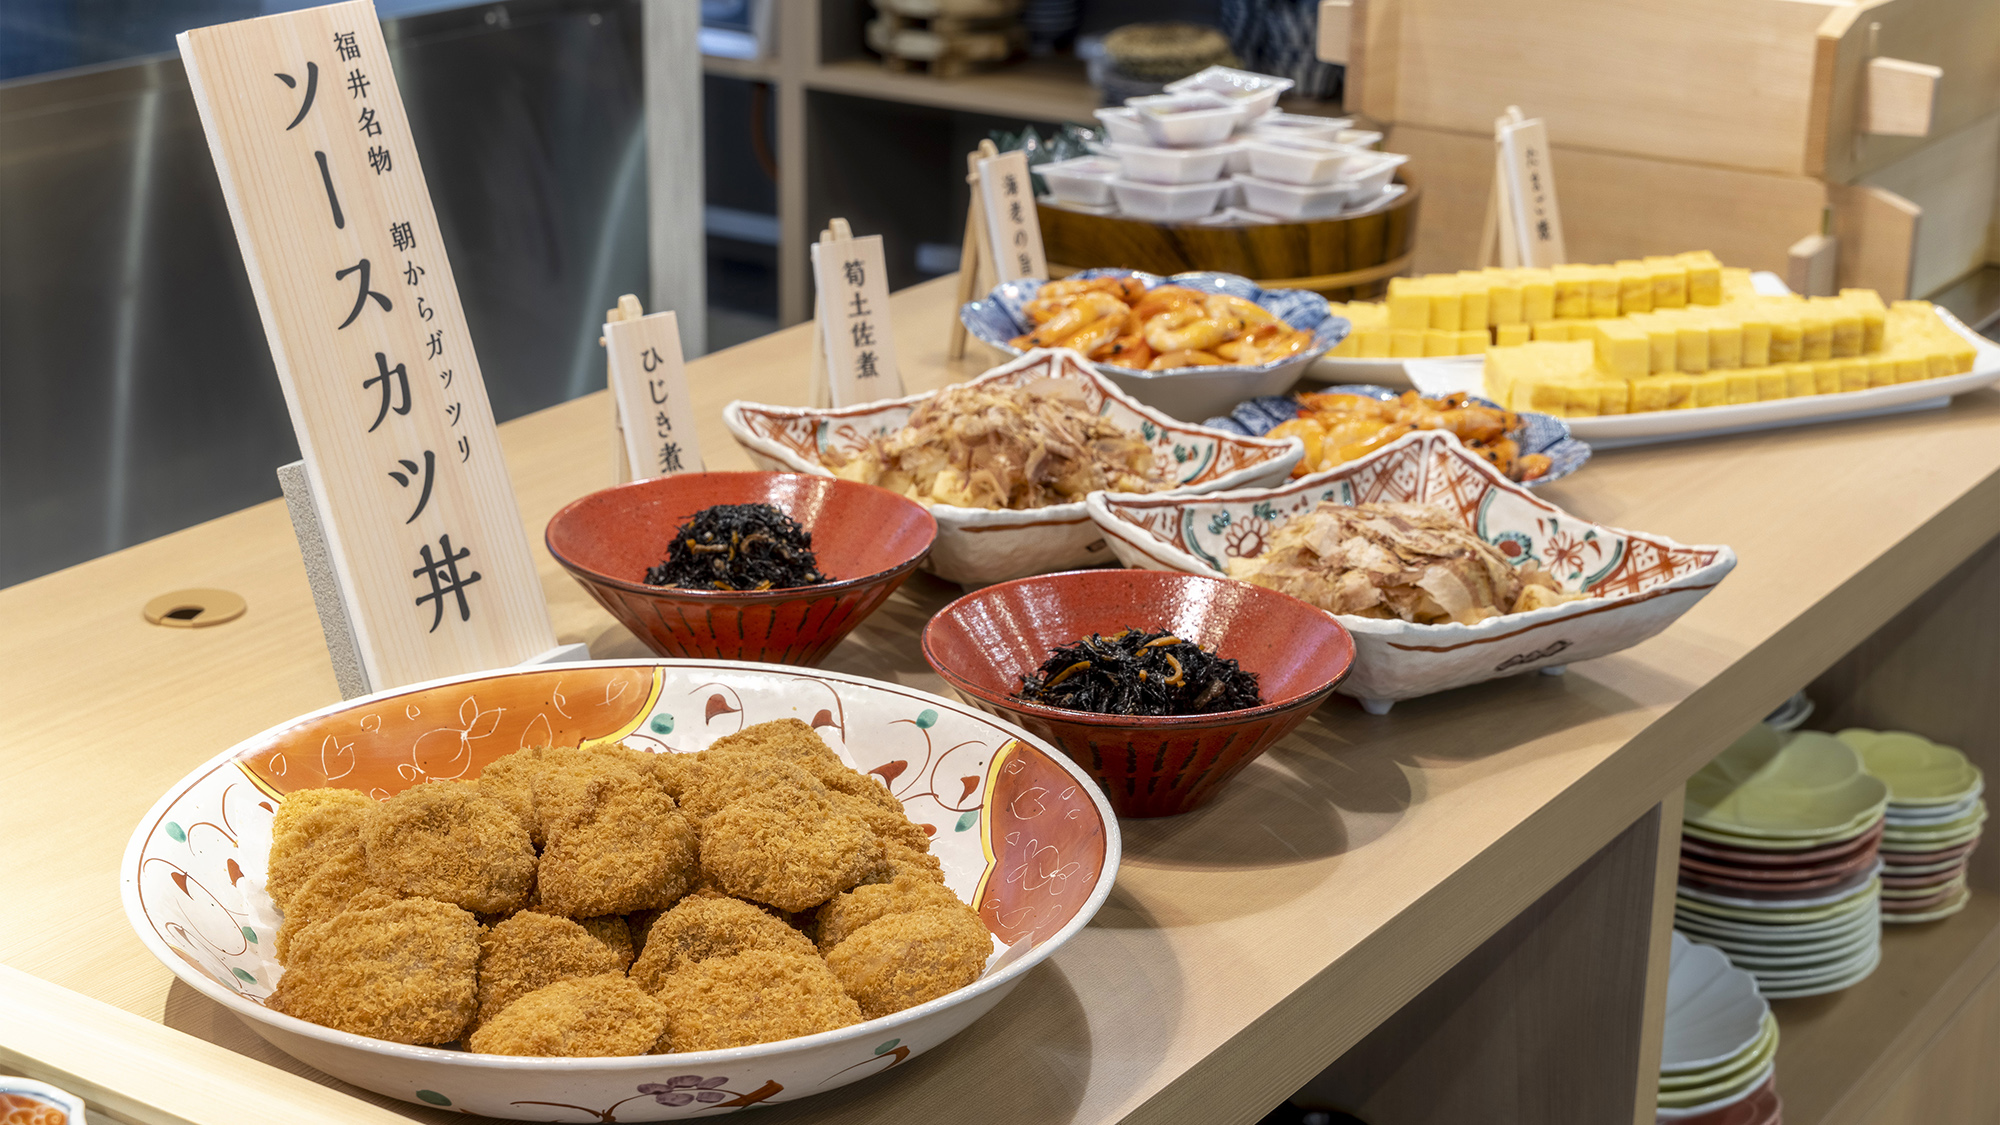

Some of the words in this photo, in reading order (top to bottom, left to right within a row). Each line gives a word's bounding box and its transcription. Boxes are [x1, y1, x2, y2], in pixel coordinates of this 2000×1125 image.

[333, 31, 393, 176] 福井名物
[273, 60, 482, 634] ソースカツ丼
[843, 258, 880, 379] 筍土佐煮
[641, 347, 685, 474] ひじき煮
